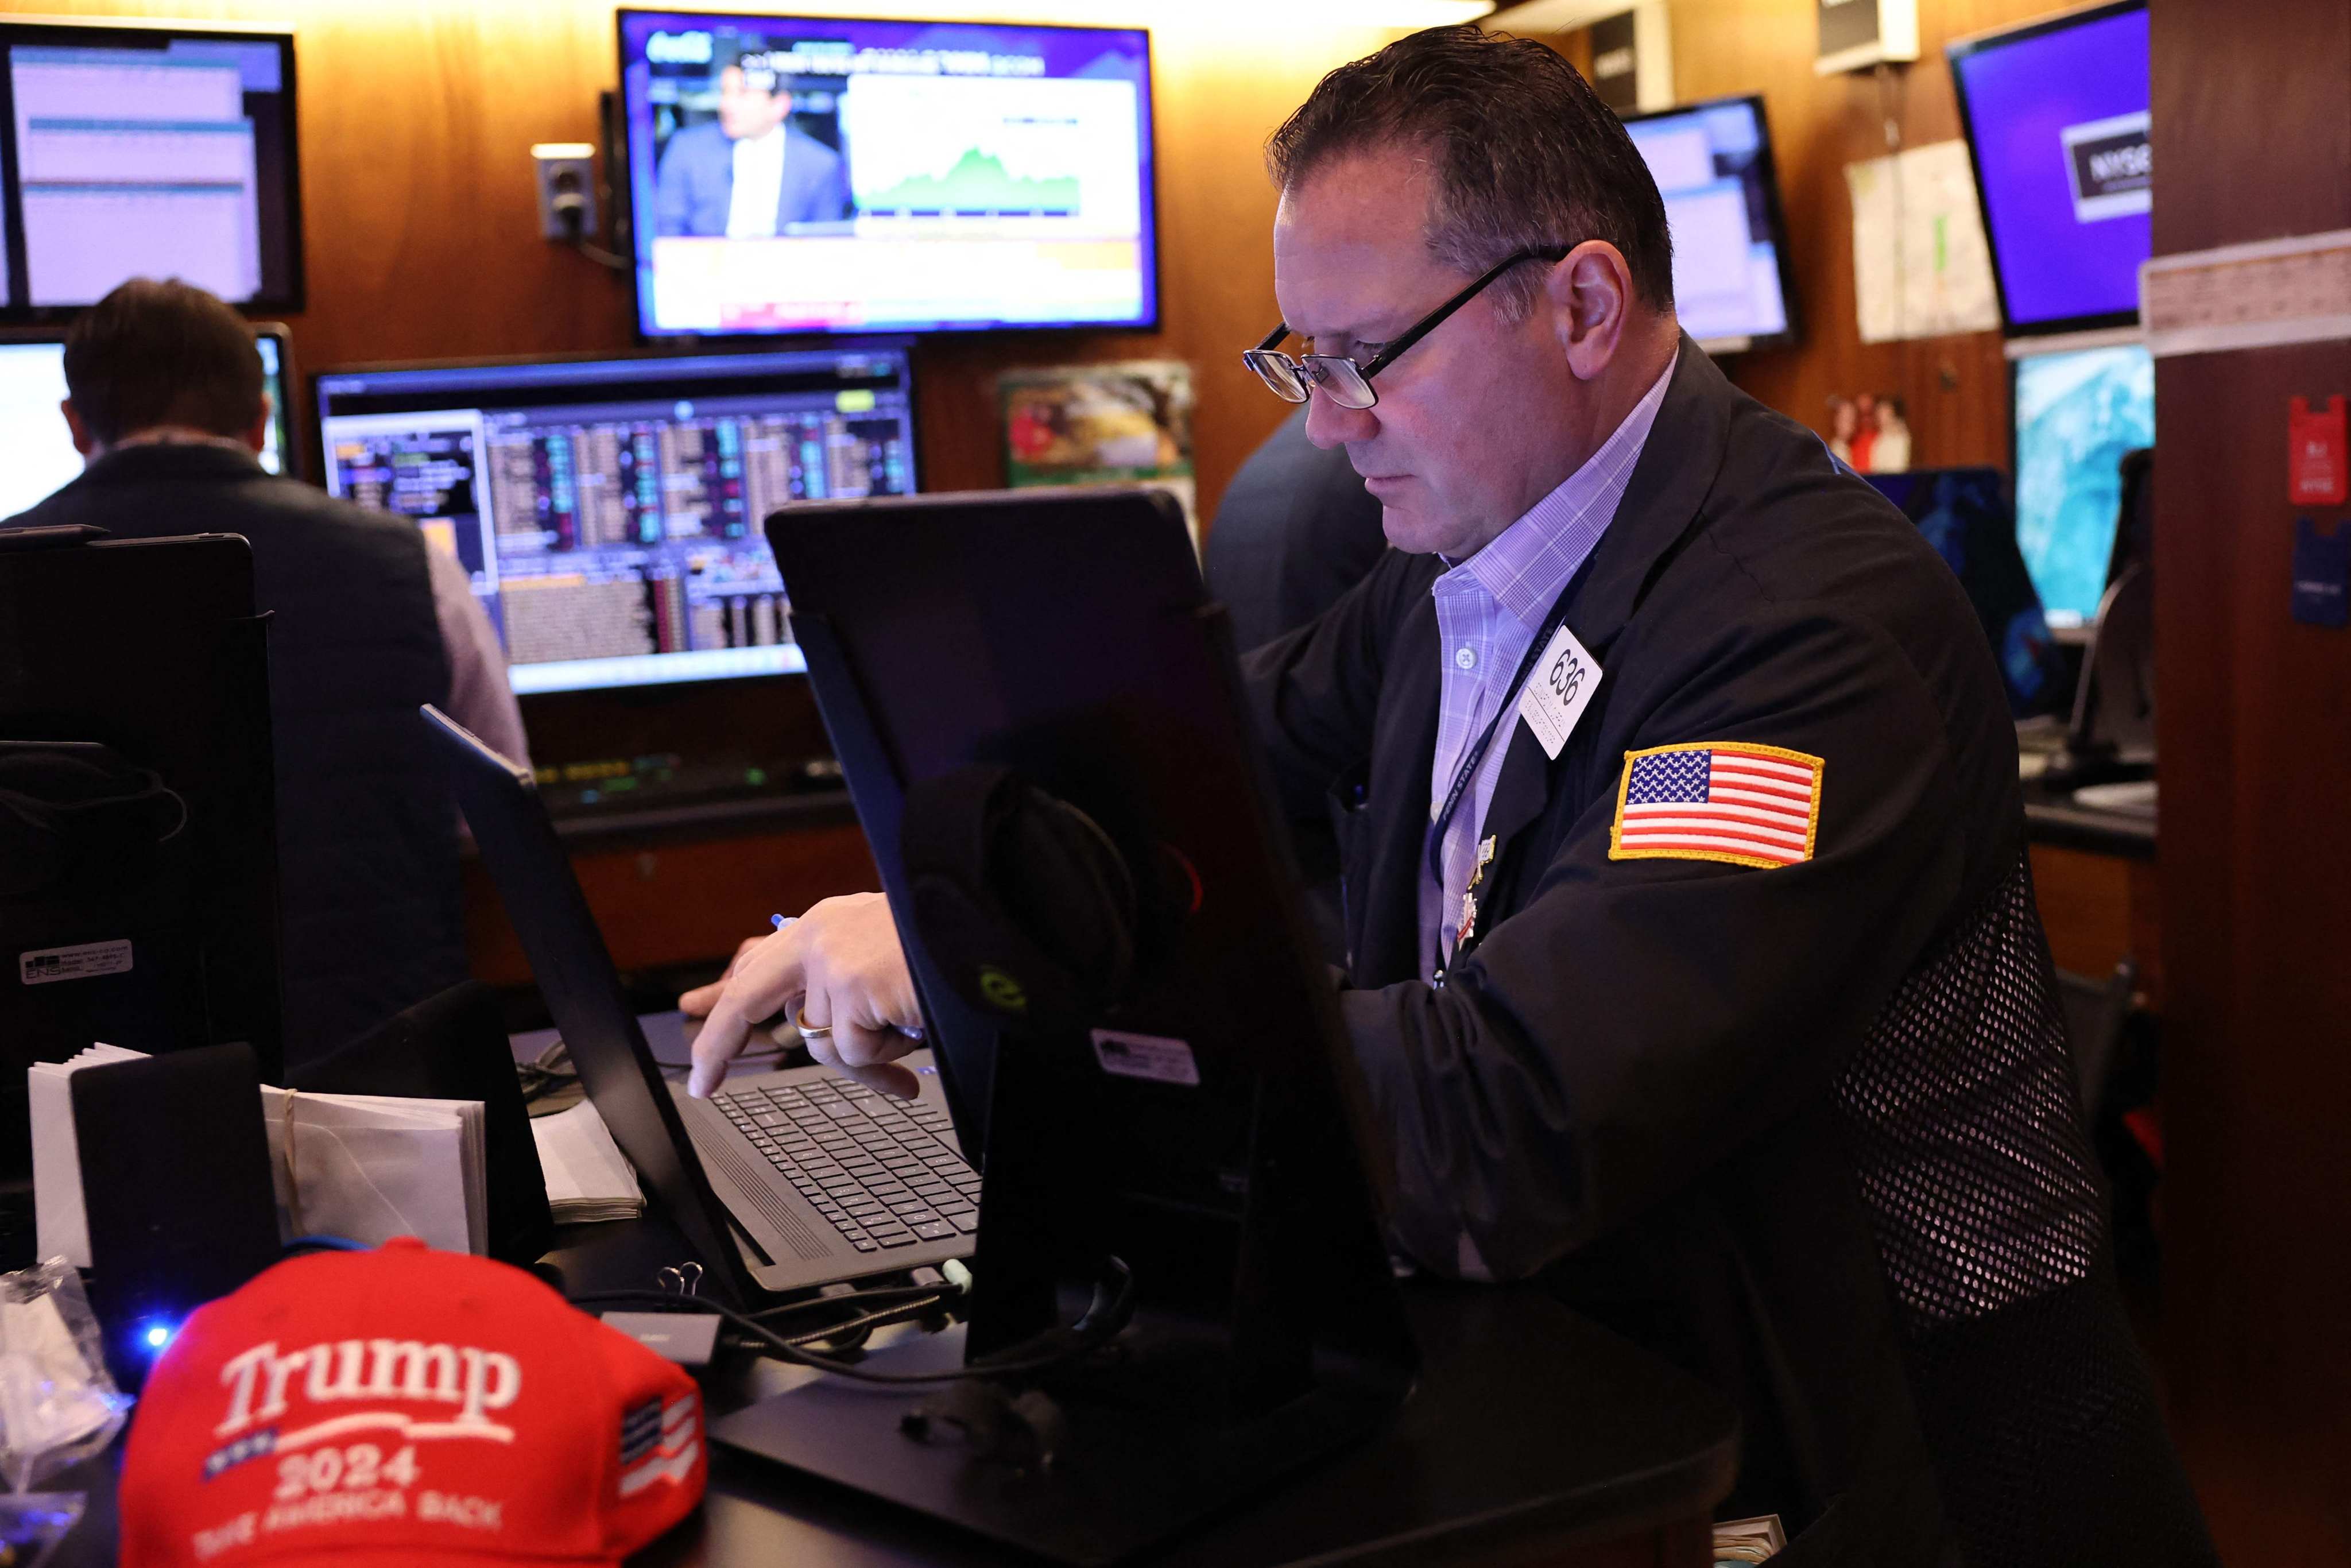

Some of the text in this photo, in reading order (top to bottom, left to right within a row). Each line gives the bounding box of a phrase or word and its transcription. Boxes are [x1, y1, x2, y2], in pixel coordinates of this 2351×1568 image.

[1550, 648, 1585, 706] 636
[26, 966, 60, 978] ENS
[214, 1338, 521, 1438] Trump
[274, 1444, 420, 1500] 2024
[417, 1491, 503, 1534] BACK
